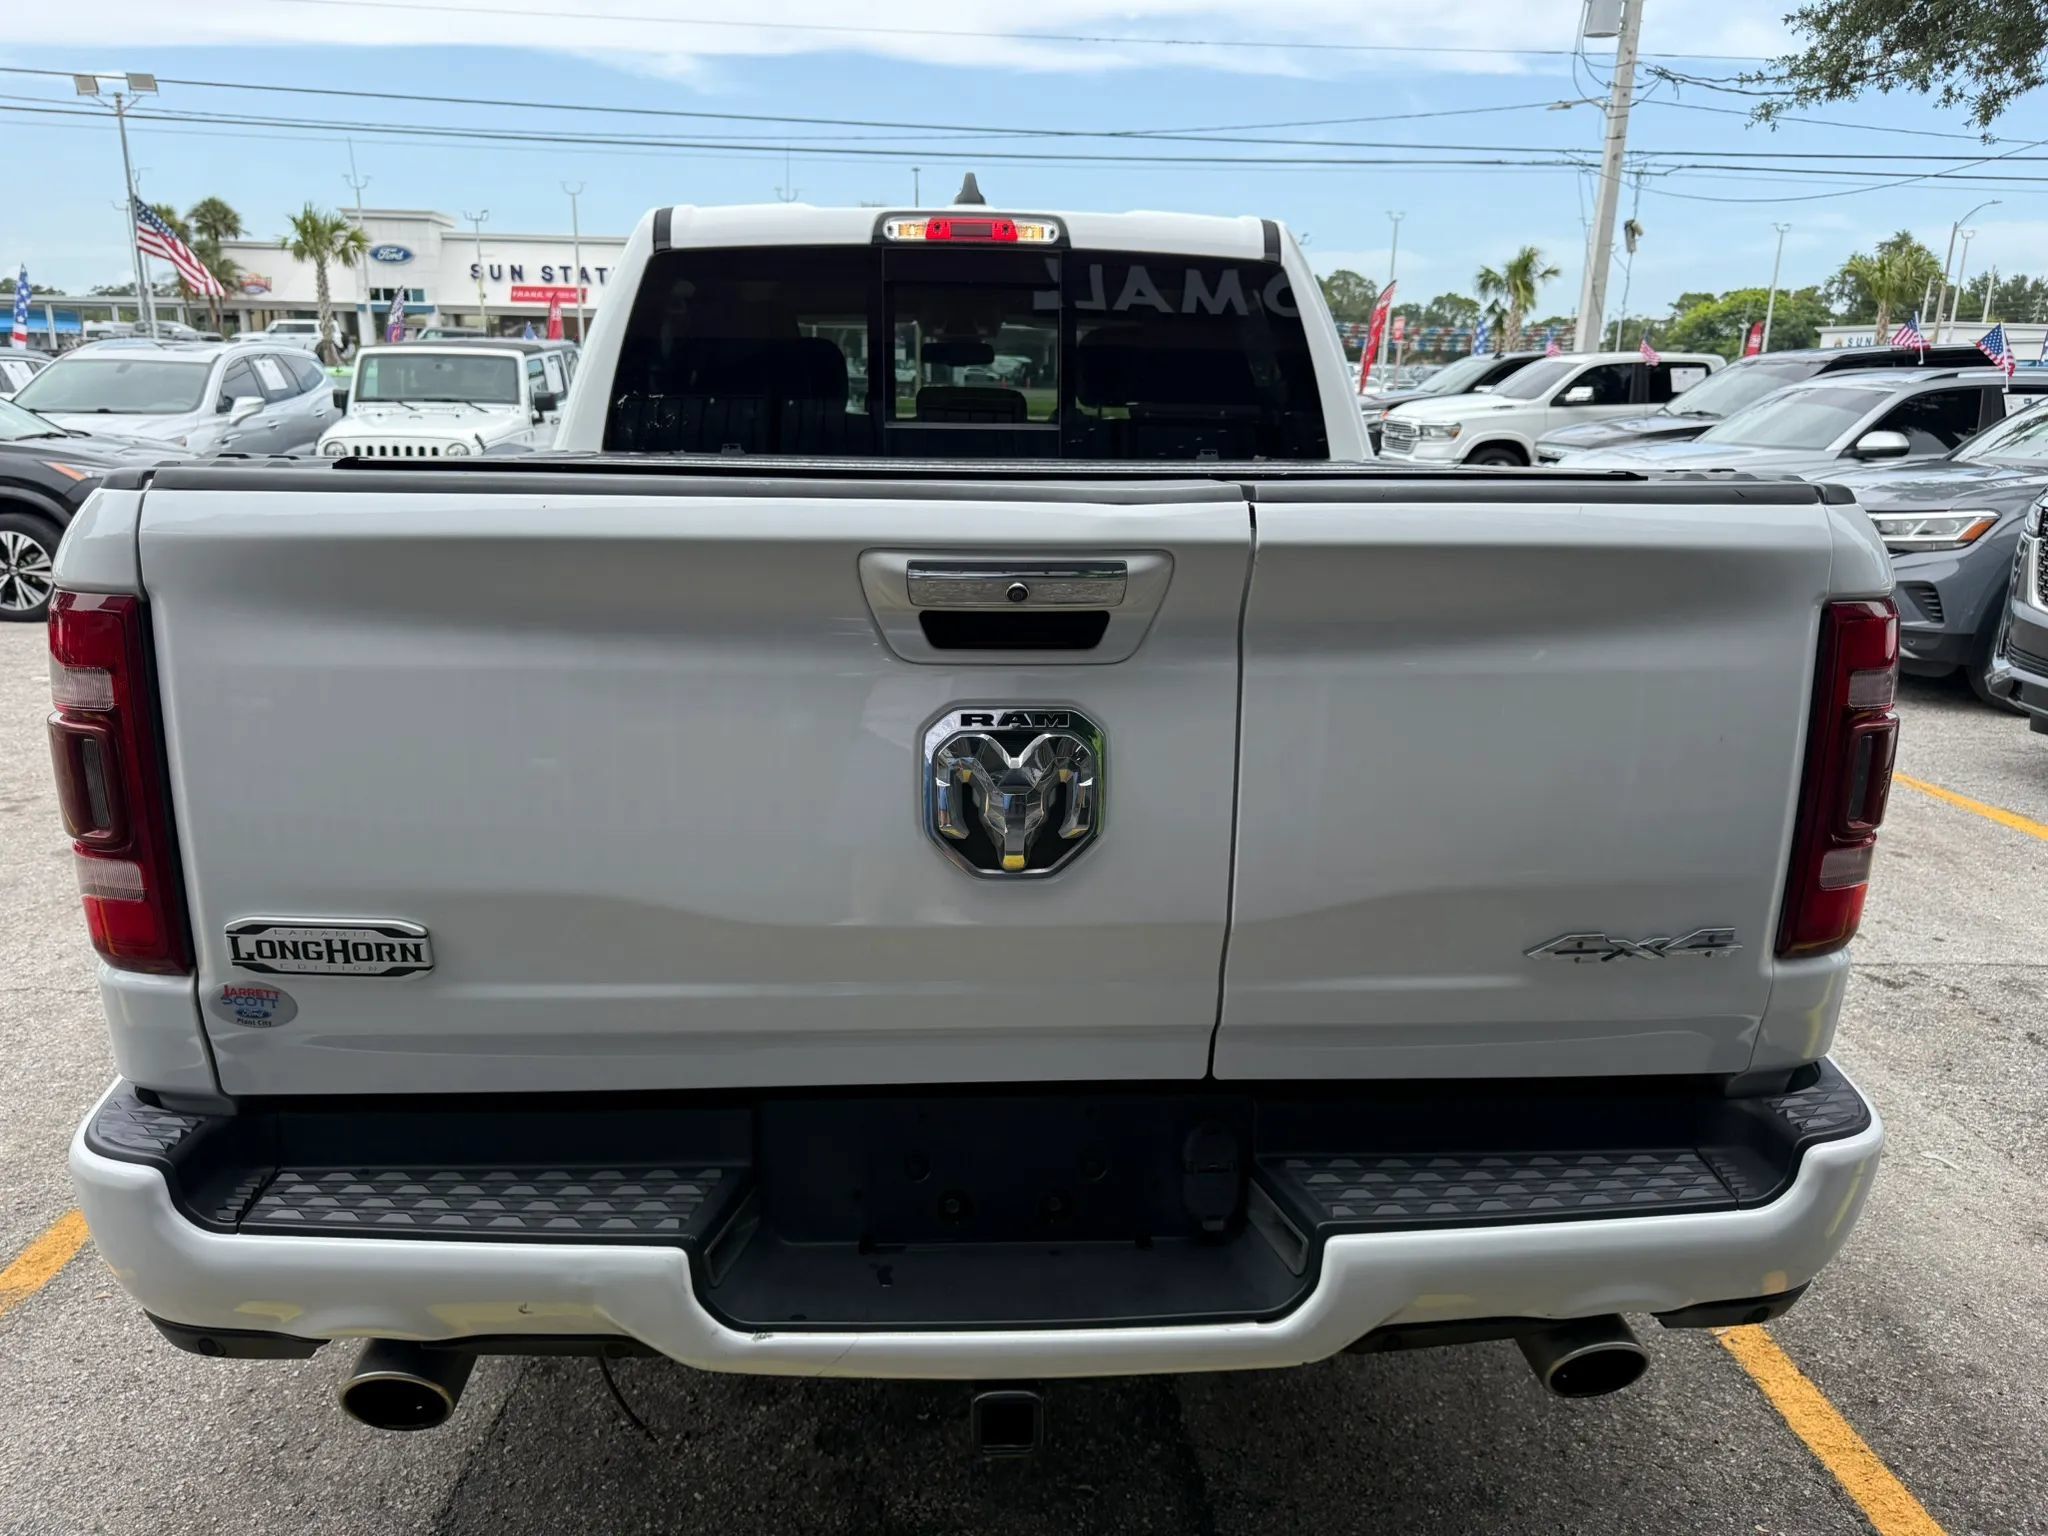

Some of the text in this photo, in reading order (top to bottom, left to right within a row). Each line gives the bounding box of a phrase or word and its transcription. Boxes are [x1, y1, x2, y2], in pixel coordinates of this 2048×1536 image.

[377, 247, 404, 260] Ford
[470, 263, 615, 285] SUN STAT
[1848, 336, 1873, 347] SUN
[960, 712, 1070, 728] RAM
[223, 984, 281, 999] JARRETT
[221, 996, 280, 1008] SCOTT
[236, 1018, 256, 1026] Plant
